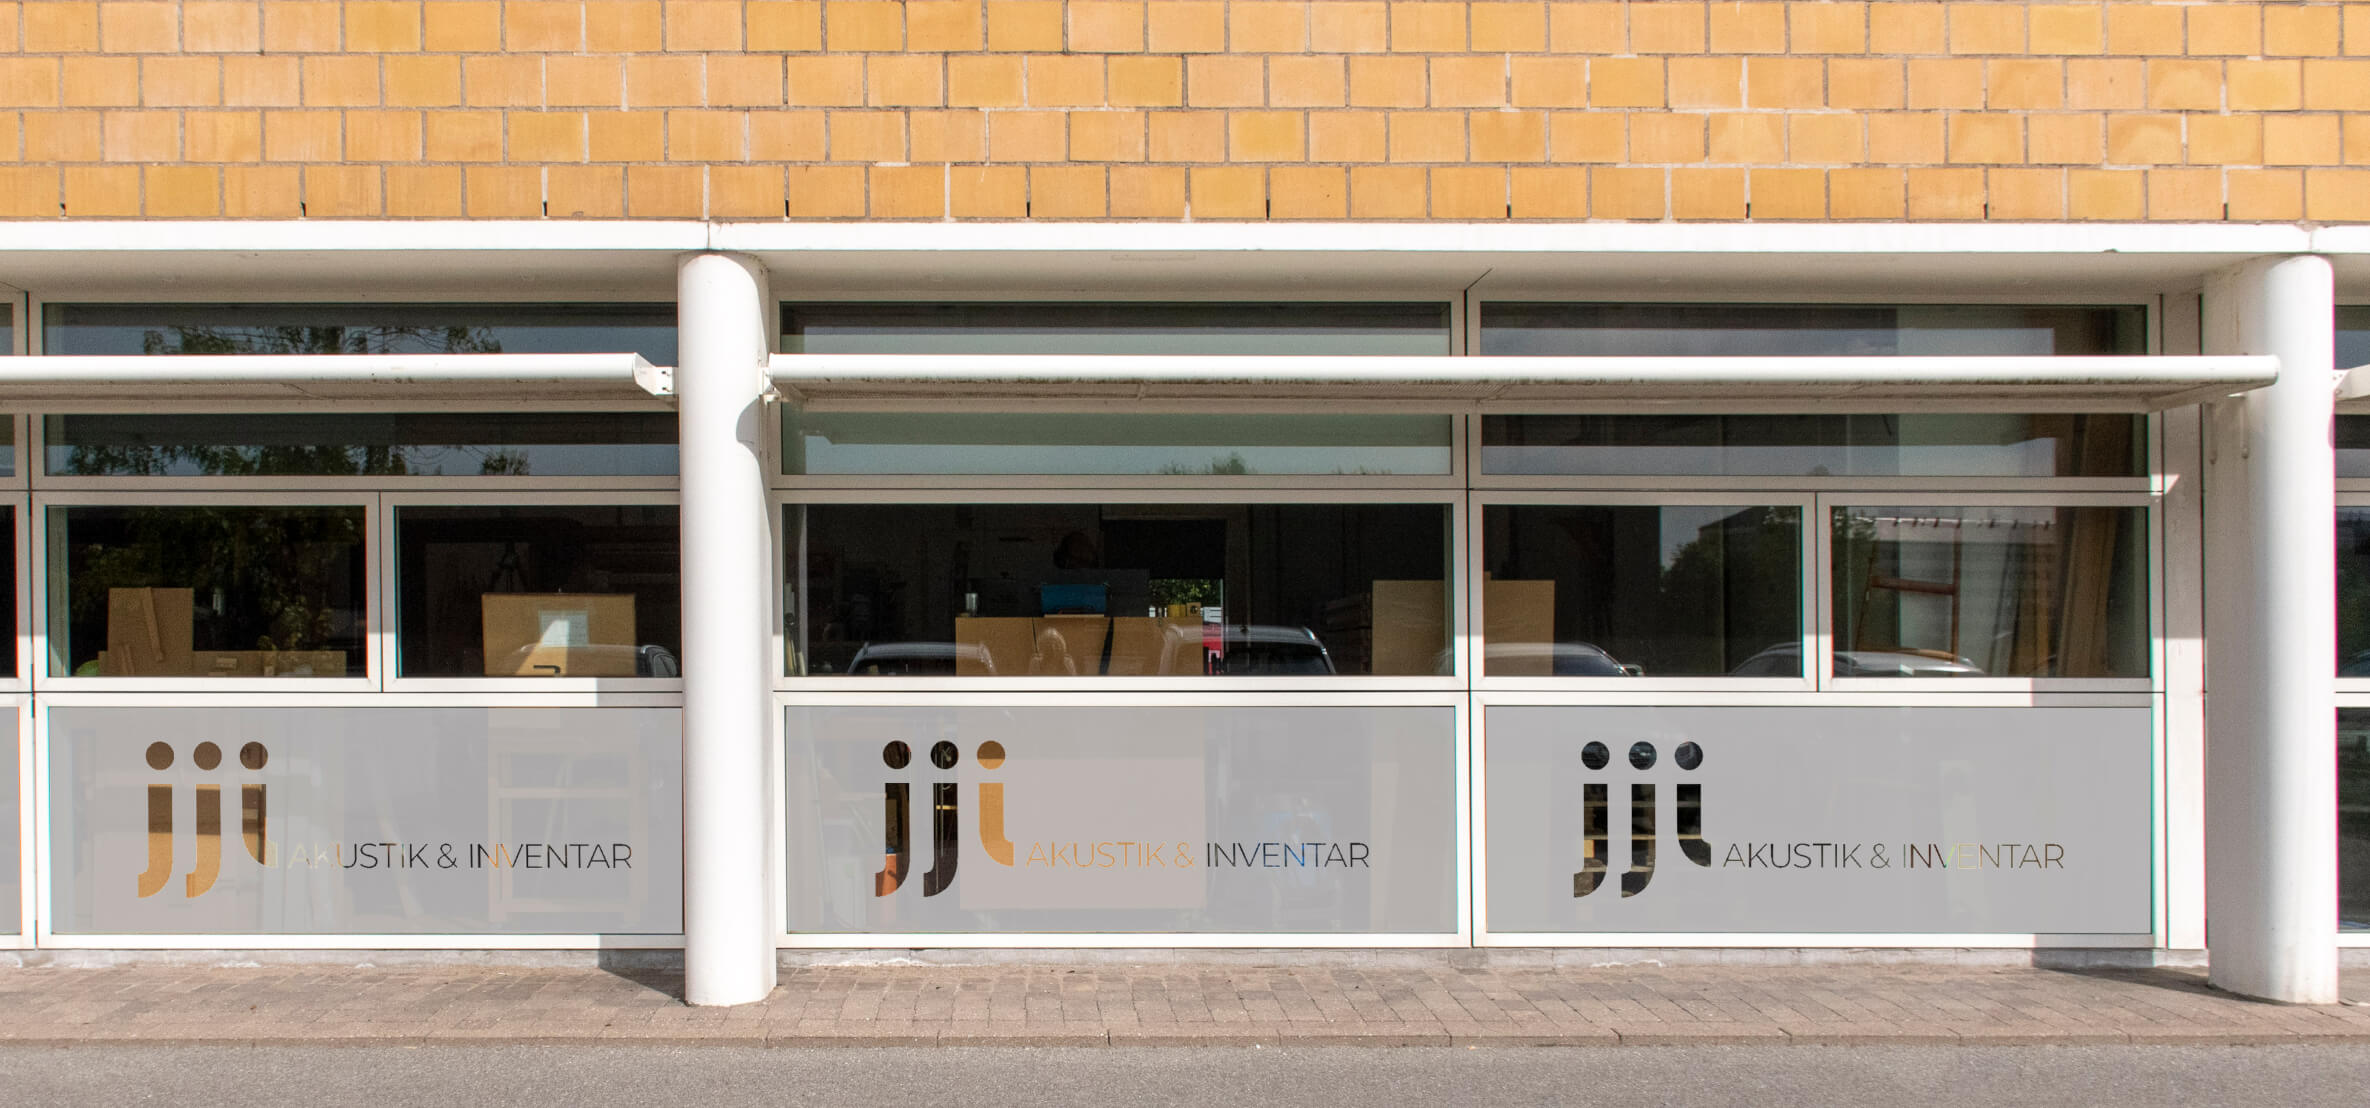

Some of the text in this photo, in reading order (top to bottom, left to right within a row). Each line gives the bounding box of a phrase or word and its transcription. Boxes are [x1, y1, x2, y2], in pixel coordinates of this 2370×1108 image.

[287, 842, 633, 869] AKUSTIK & INVENTAR
[1026, 842, 1370, 868] AKUSTIK & INVENTAR
[1722, 842, 2065, 869] AKUSTIK & INVENTAR
